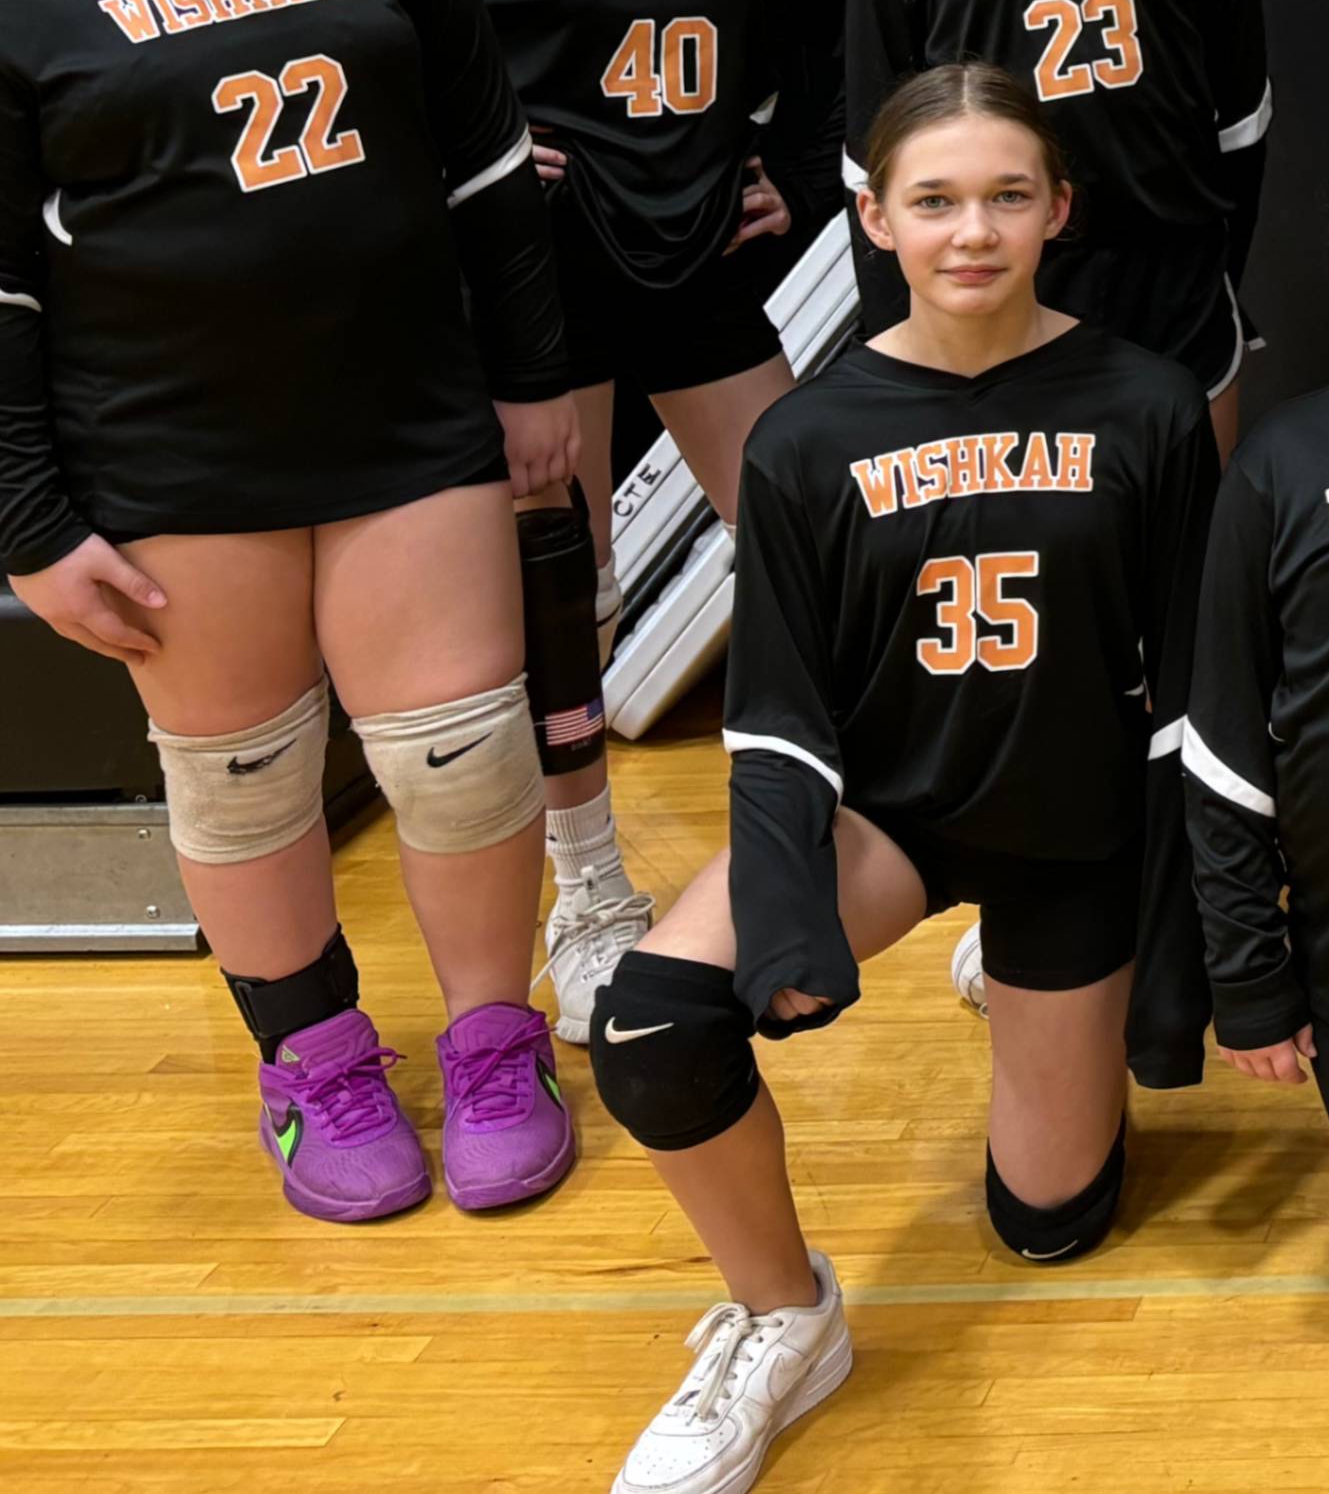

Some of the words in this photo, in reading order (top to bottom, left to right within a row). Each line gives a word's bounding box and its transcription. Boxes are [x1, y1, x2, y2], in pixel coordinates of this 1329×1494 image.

[600, 17, 718, 117] 40
[211, 54, 366, 193] 22
[850, 432, 1096, 519] WISHKAH
[917, 551, 1039, 676] 35
